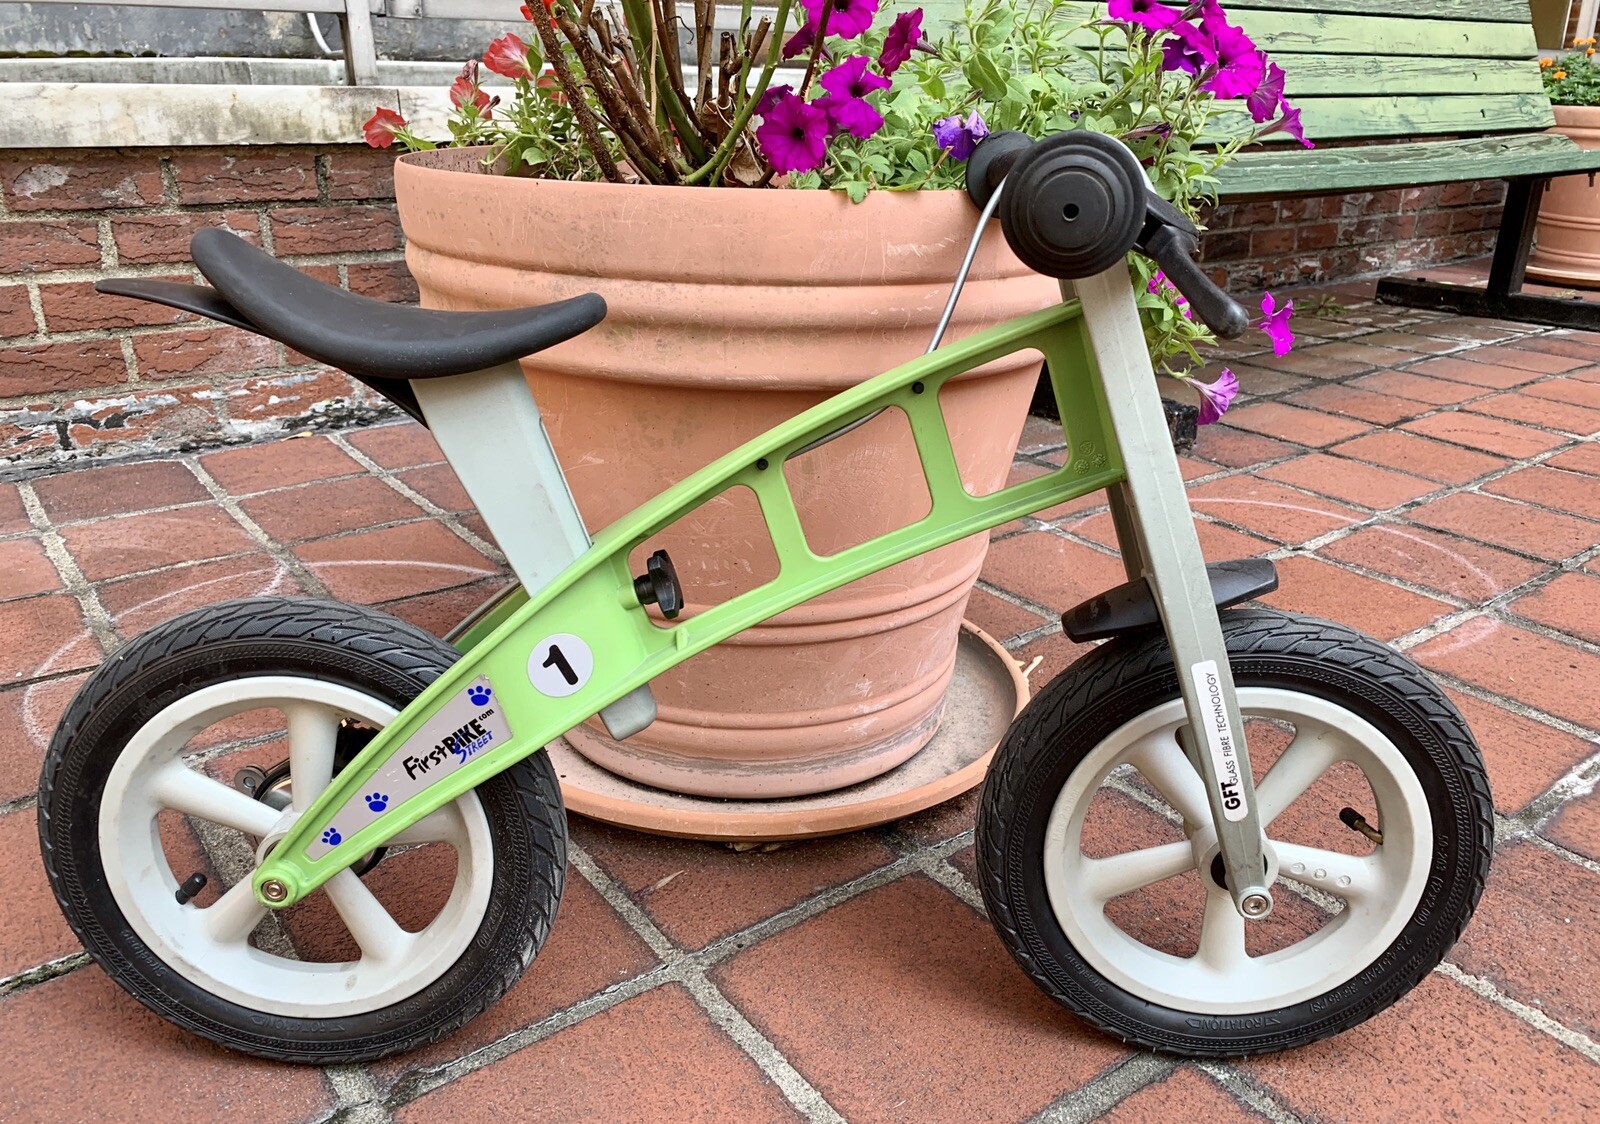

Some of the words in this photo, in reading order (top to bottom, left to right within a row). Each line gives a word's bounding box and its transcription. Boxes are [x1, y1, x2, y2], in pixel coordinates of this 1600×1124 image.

[542, 644, 579, 686] 1
[1205, 672, 1228, 733] TECHNOLOGY
[453, 731, 493, 764] STREET
[1220, 736, 1233, 757] FIBRE
[1225, 760, 1239, 786] GLASS
[1220, 782, 1241, 811] GFT
[1201, 1016, 1262, 1030] ROTATION
